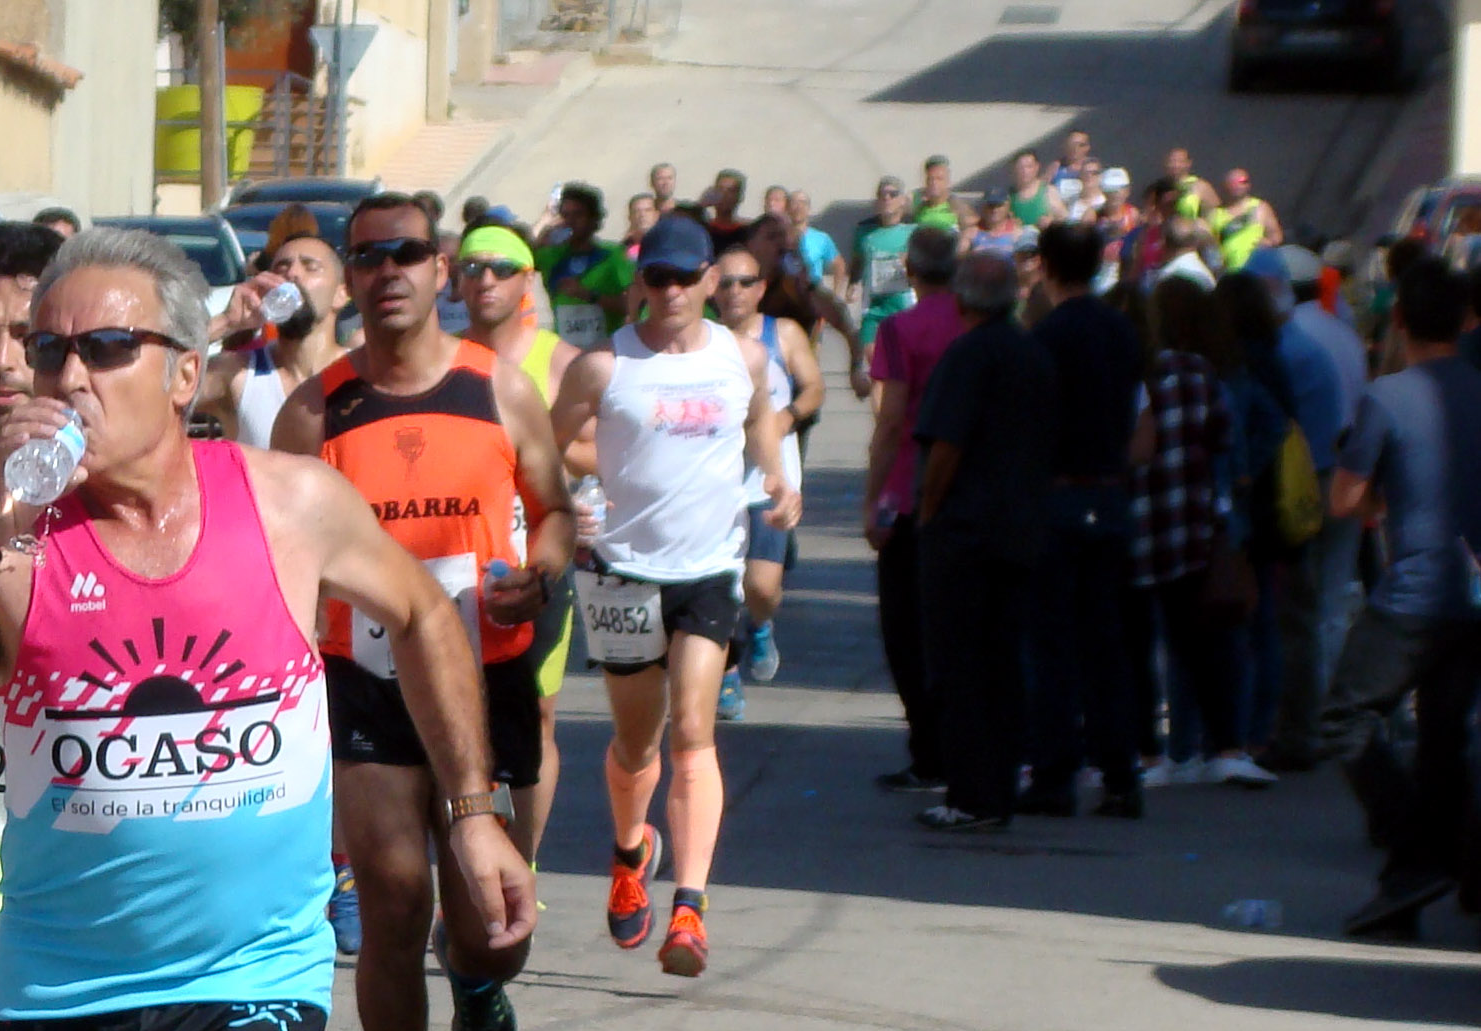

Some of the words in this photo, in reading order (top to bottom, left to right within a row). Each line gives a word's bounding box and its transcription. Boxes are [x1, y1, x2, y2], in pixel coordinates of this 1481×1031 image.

[70, 599, 106, 613] mobel
[587, 603, 652, 634] 34852
[50, 720, 283, 781] OCASO
[50, 796, 66, 813] El
[71, 798, 95, 816] sol
[102, 799, 128, 817] de
[136, 799, 154, 816] la
[163, 783, 286, 815] tranquilidad
